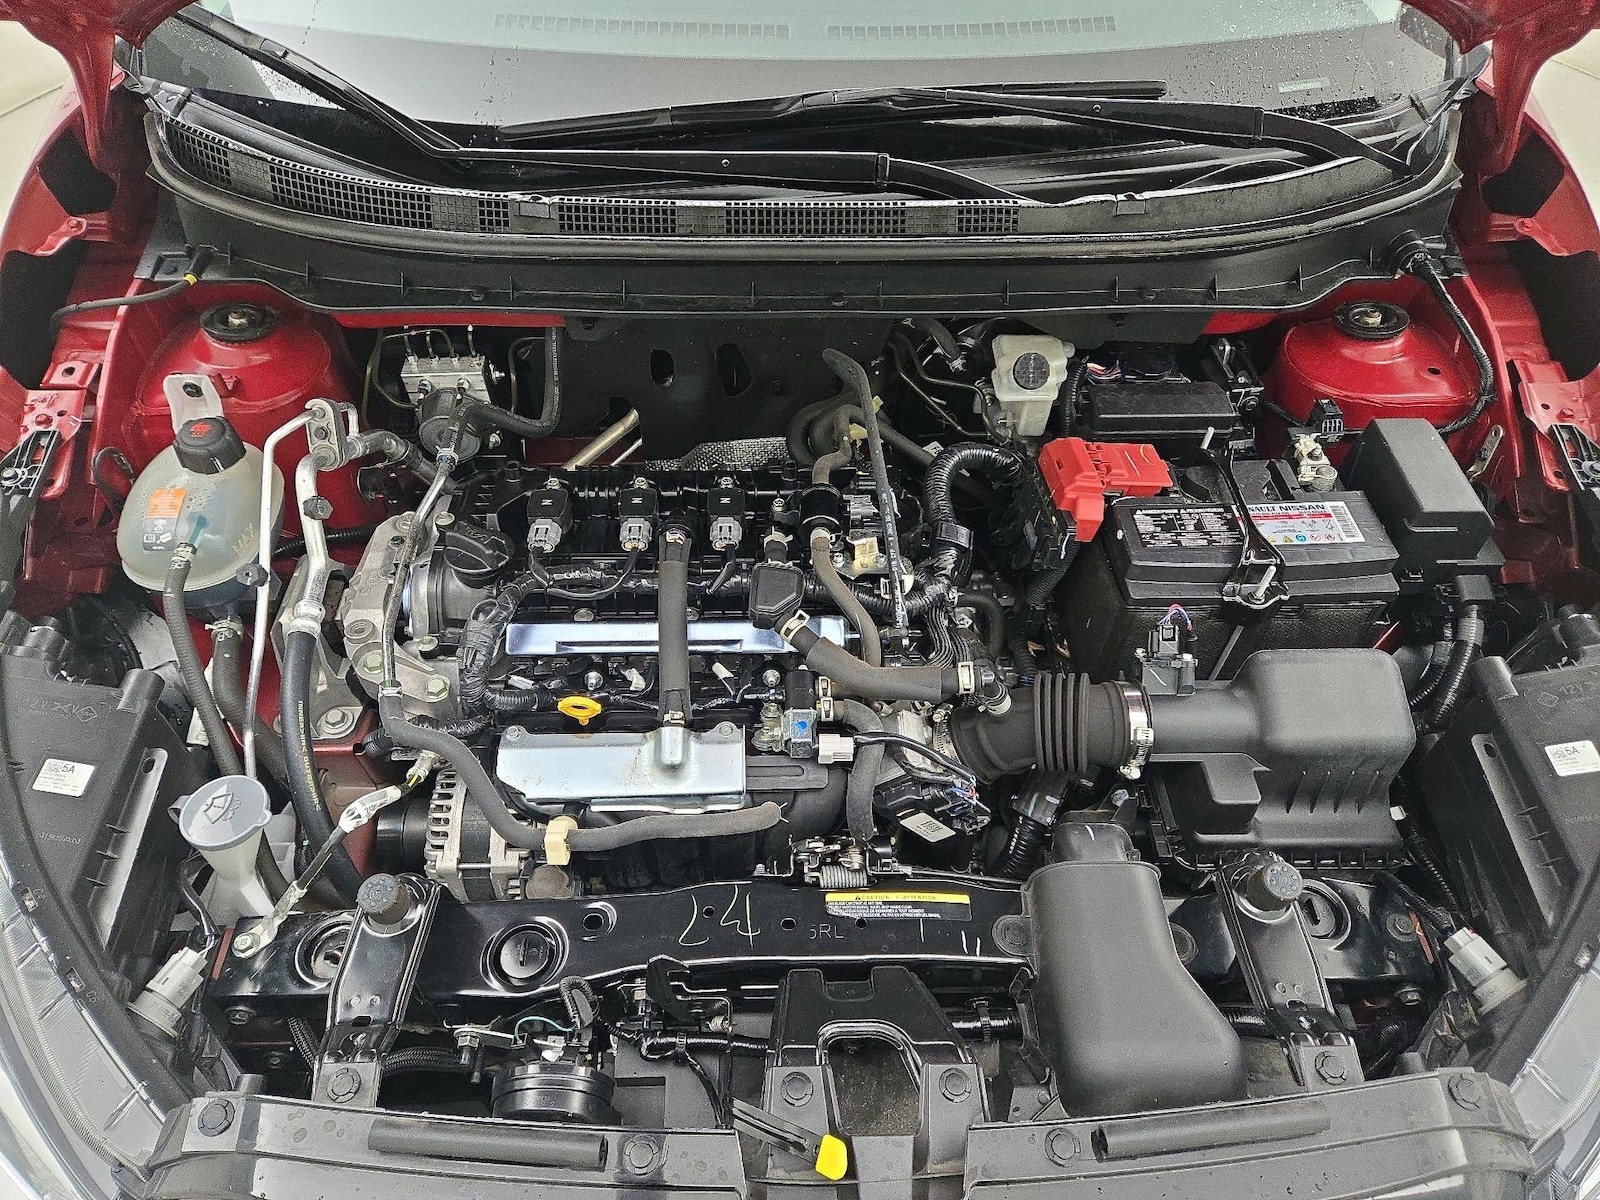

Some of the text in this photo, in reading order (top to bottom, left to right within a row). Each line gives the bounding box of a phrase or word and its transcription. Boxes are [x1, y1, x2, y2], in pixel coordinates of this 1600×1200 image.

[1279, 504, 1326, 512] NISSAN
[1564, 745, 1580, 756] 5A
[61, 762, 75, 774] 5A
